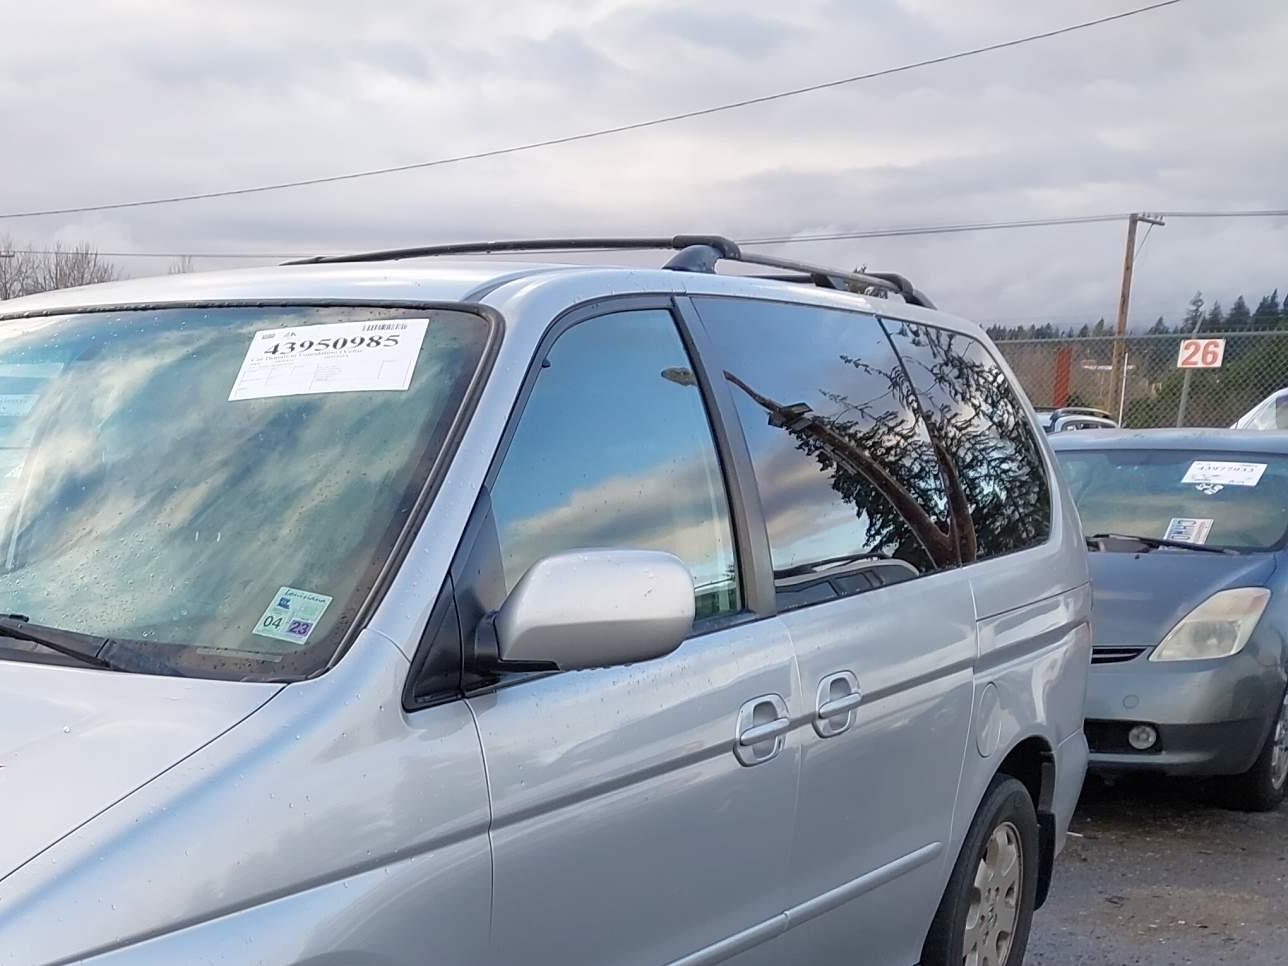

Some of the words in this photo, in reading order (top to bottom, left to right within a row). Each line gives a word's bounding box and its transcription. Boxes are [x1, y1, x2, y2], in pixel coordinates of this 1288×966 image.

[264, 334, 400, 355] 43950985
[1181, 341, 1219, 366] 26
[263, 615, 282, 630] 04
[289, 620, 310, 635] 23
